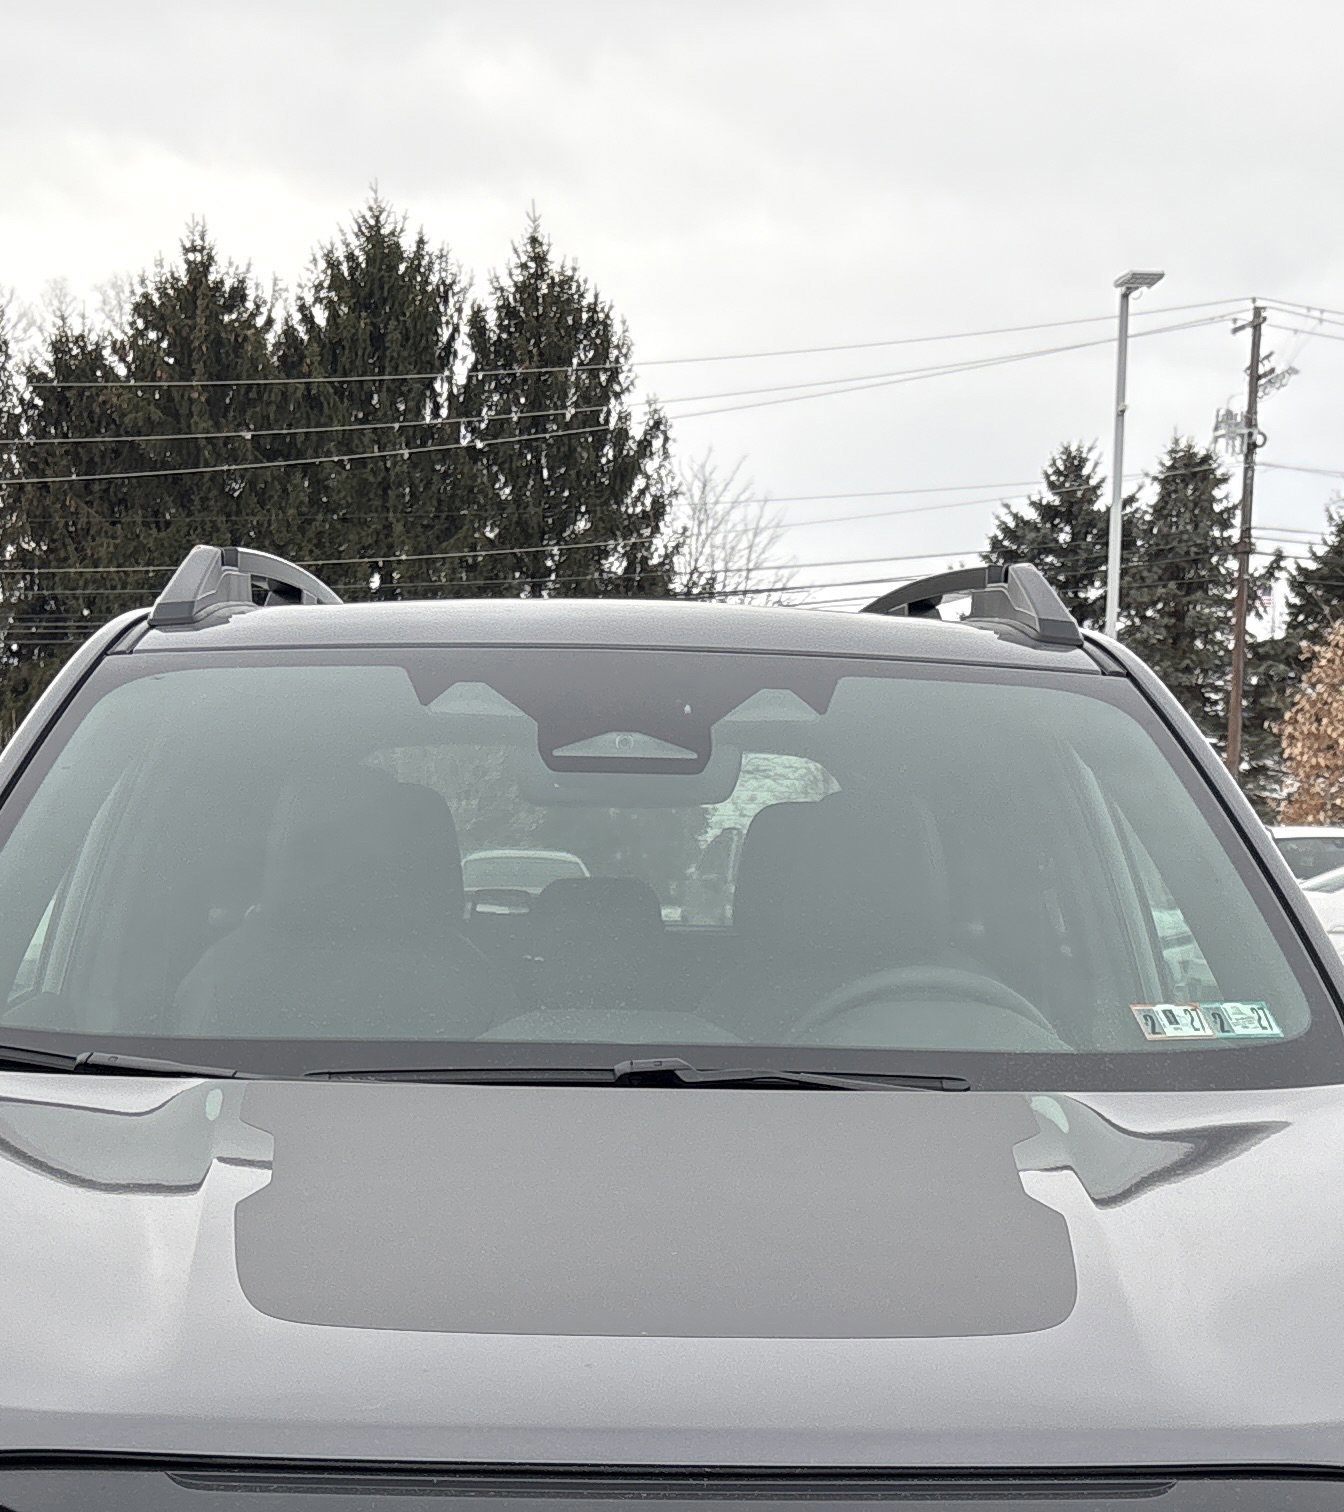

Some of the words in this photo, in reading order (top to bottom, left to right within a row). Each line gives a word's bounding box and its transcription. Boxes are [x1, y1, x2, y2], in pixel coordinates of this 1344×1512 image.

[1143, 1014, 1162, 1035] 2
[1183, 1008, 1207, 1033] 27
[1211, 1012, 1231, 1033] 2
[1249, 1007, 1273, 1031] 27
